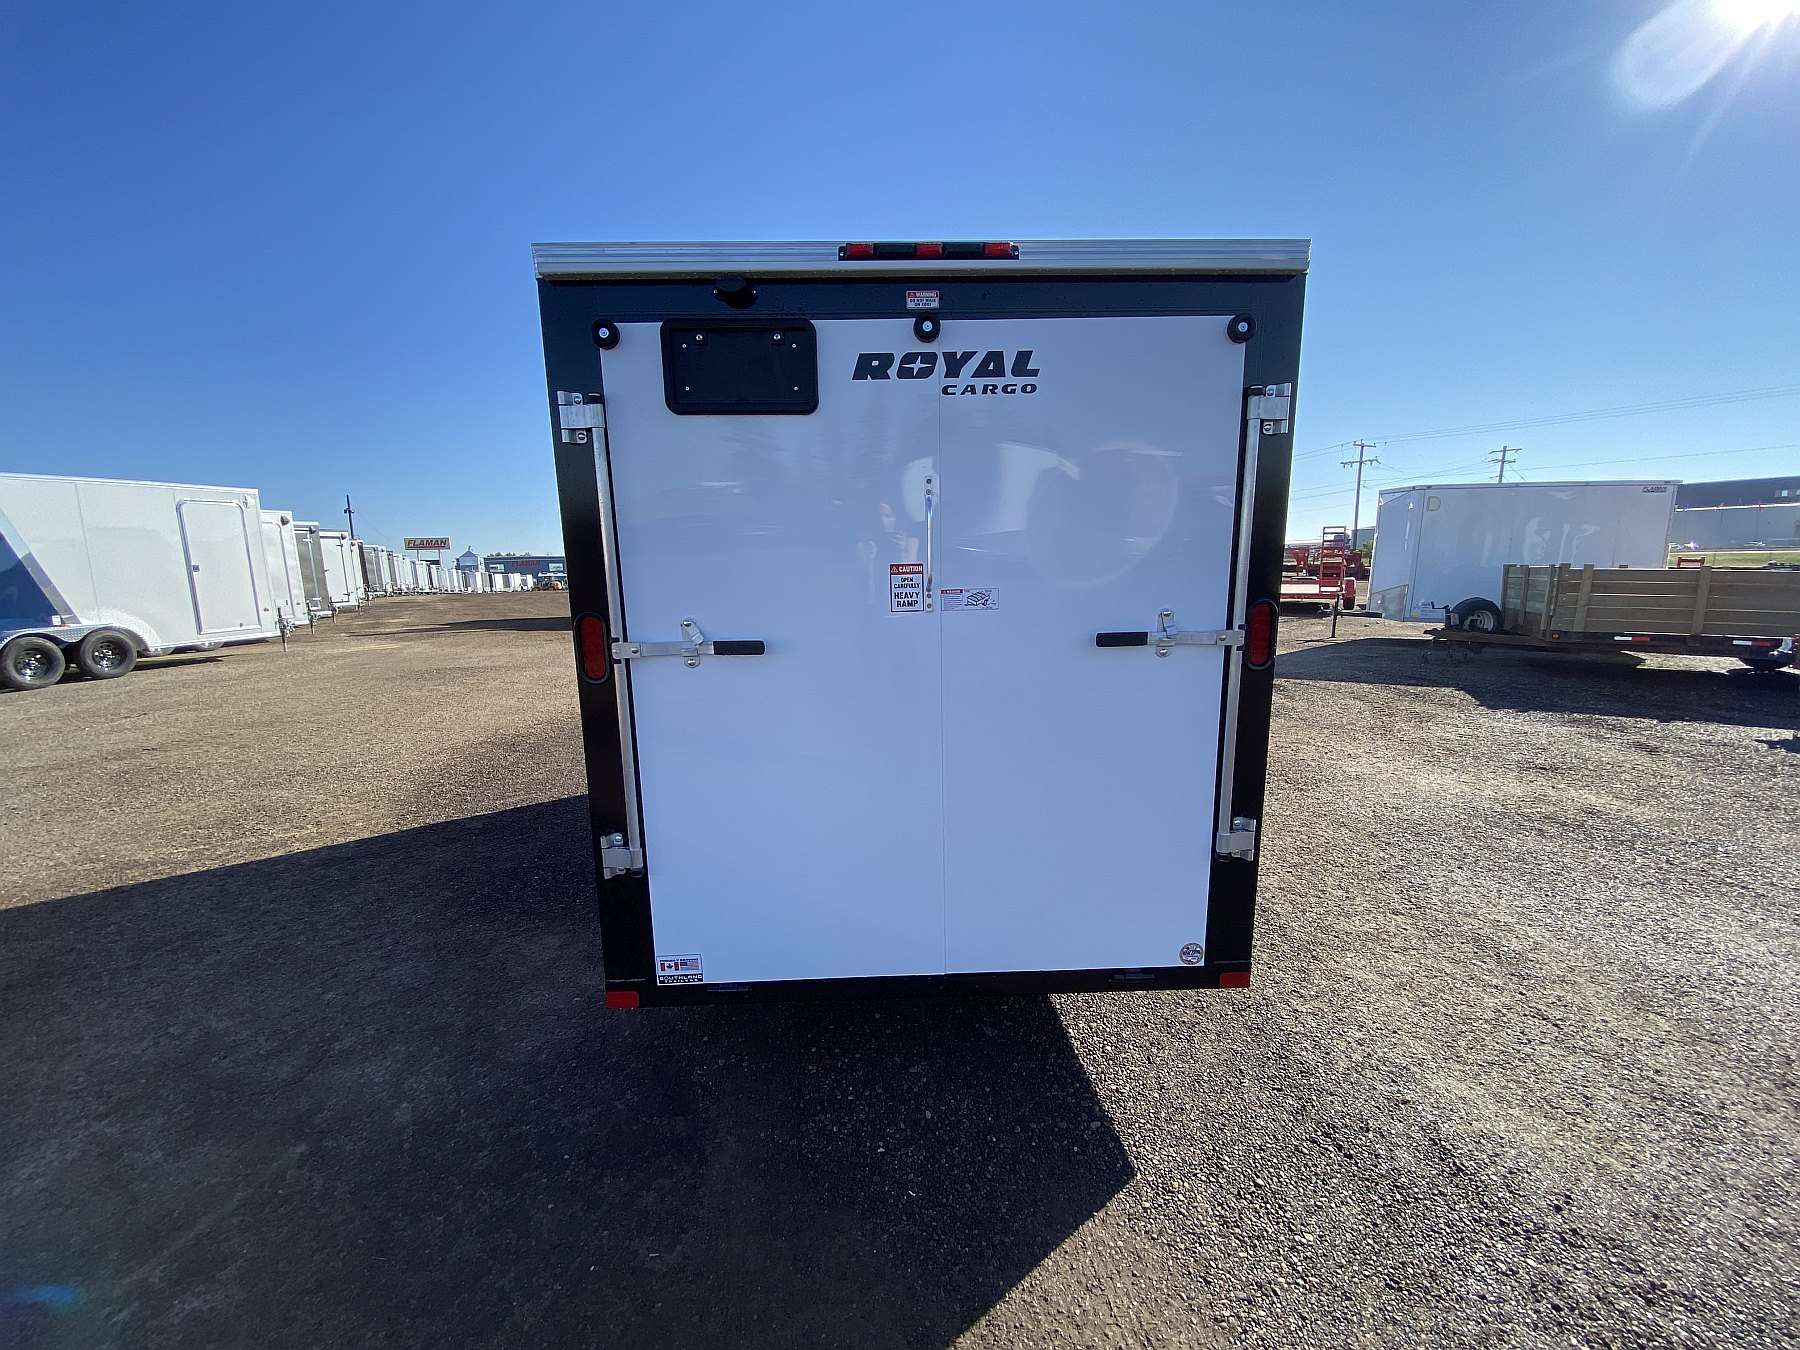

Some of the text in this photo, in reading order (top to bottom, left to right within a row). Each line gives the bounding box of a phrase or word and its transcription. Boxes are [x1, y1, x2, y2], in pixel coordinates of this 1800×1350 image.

[852, 350, 1041, 381] ROYAL
[941, 383, 1038, 396] CARGO
[407, 539, 447, 547] FLAMAN
[899, 565, 923, 573] CAUTION
[894, 591, 920, 600] HEAVY
[896, 600, 919, 608] RAMP
